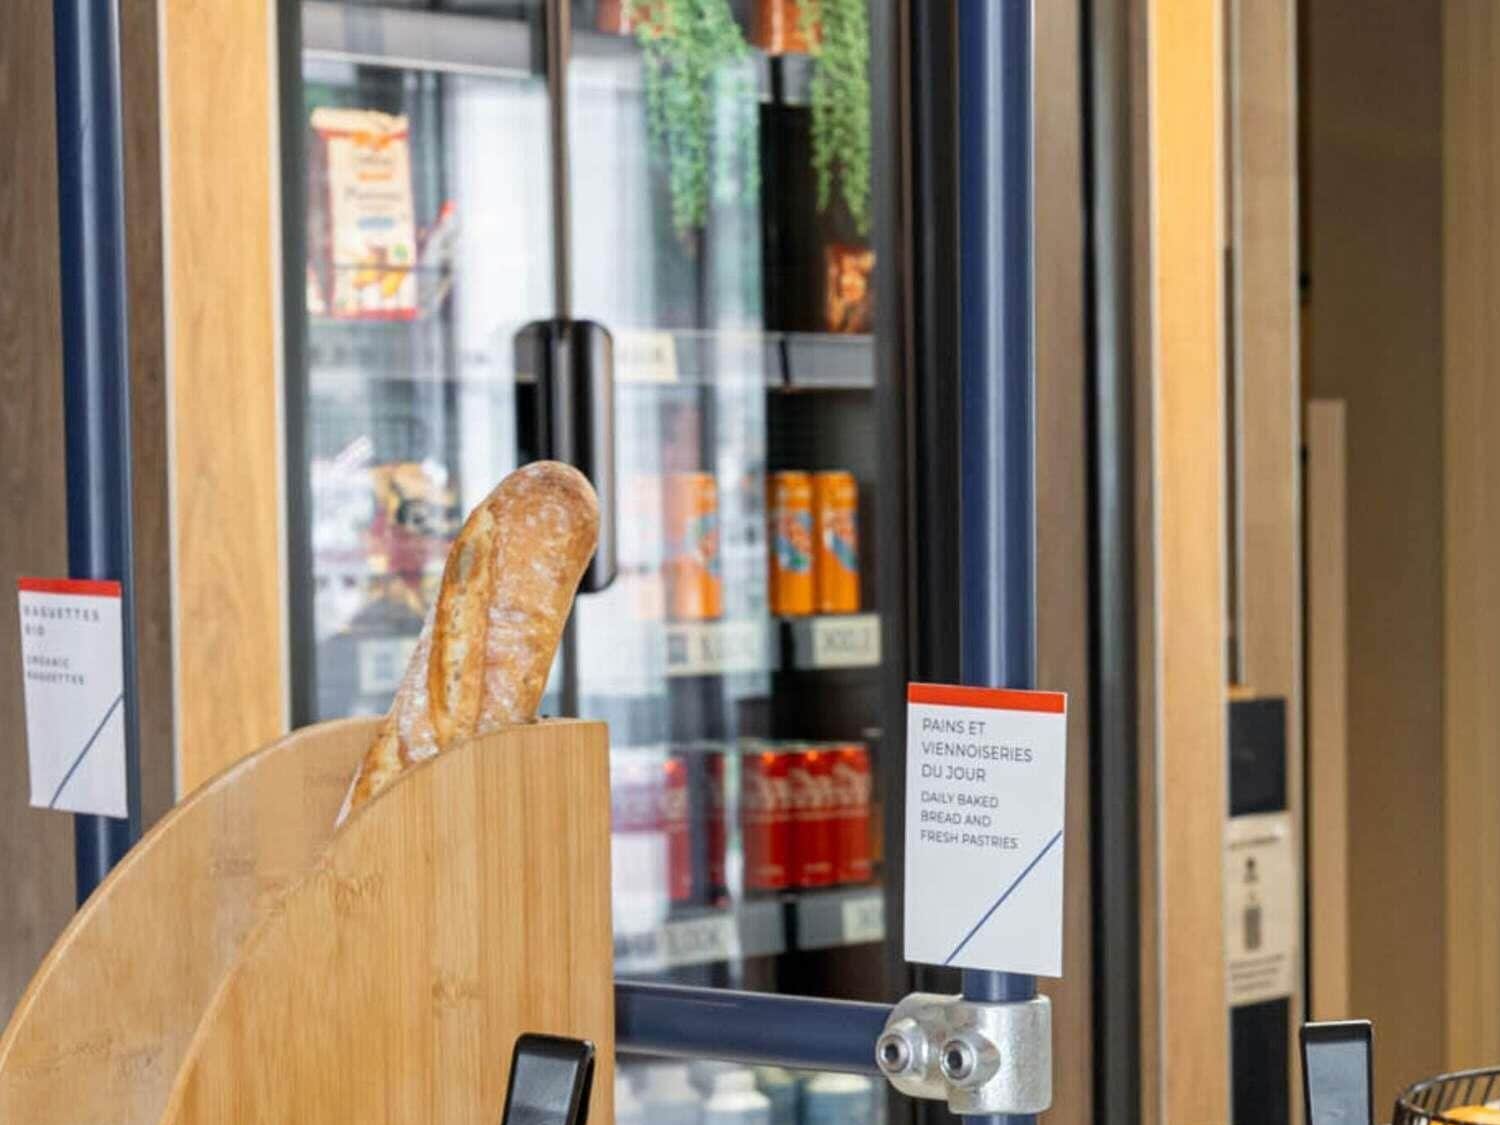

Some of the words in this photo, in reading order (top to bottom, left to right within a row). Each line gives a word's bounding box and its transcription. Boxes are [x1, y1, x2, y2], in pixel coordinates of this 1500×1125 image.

[922, 718, 965, 734] PAINS
[968, 721, 986, 735] ET
[921, 741, 1033, 762] VIENNOISERIES
[921, 764, 942, 778] DU
[945, 766, 986, 782] JOUR
[920, 791, 954, 805] DAILY
[957, 793, 999, 809] BAKED
[920, 810, 961, 825] BREAD
[964, 814, 992, 827] AND
[920, 829, 959, 844] FRESH
[961, 833, 1019, 850] PASTRIES
